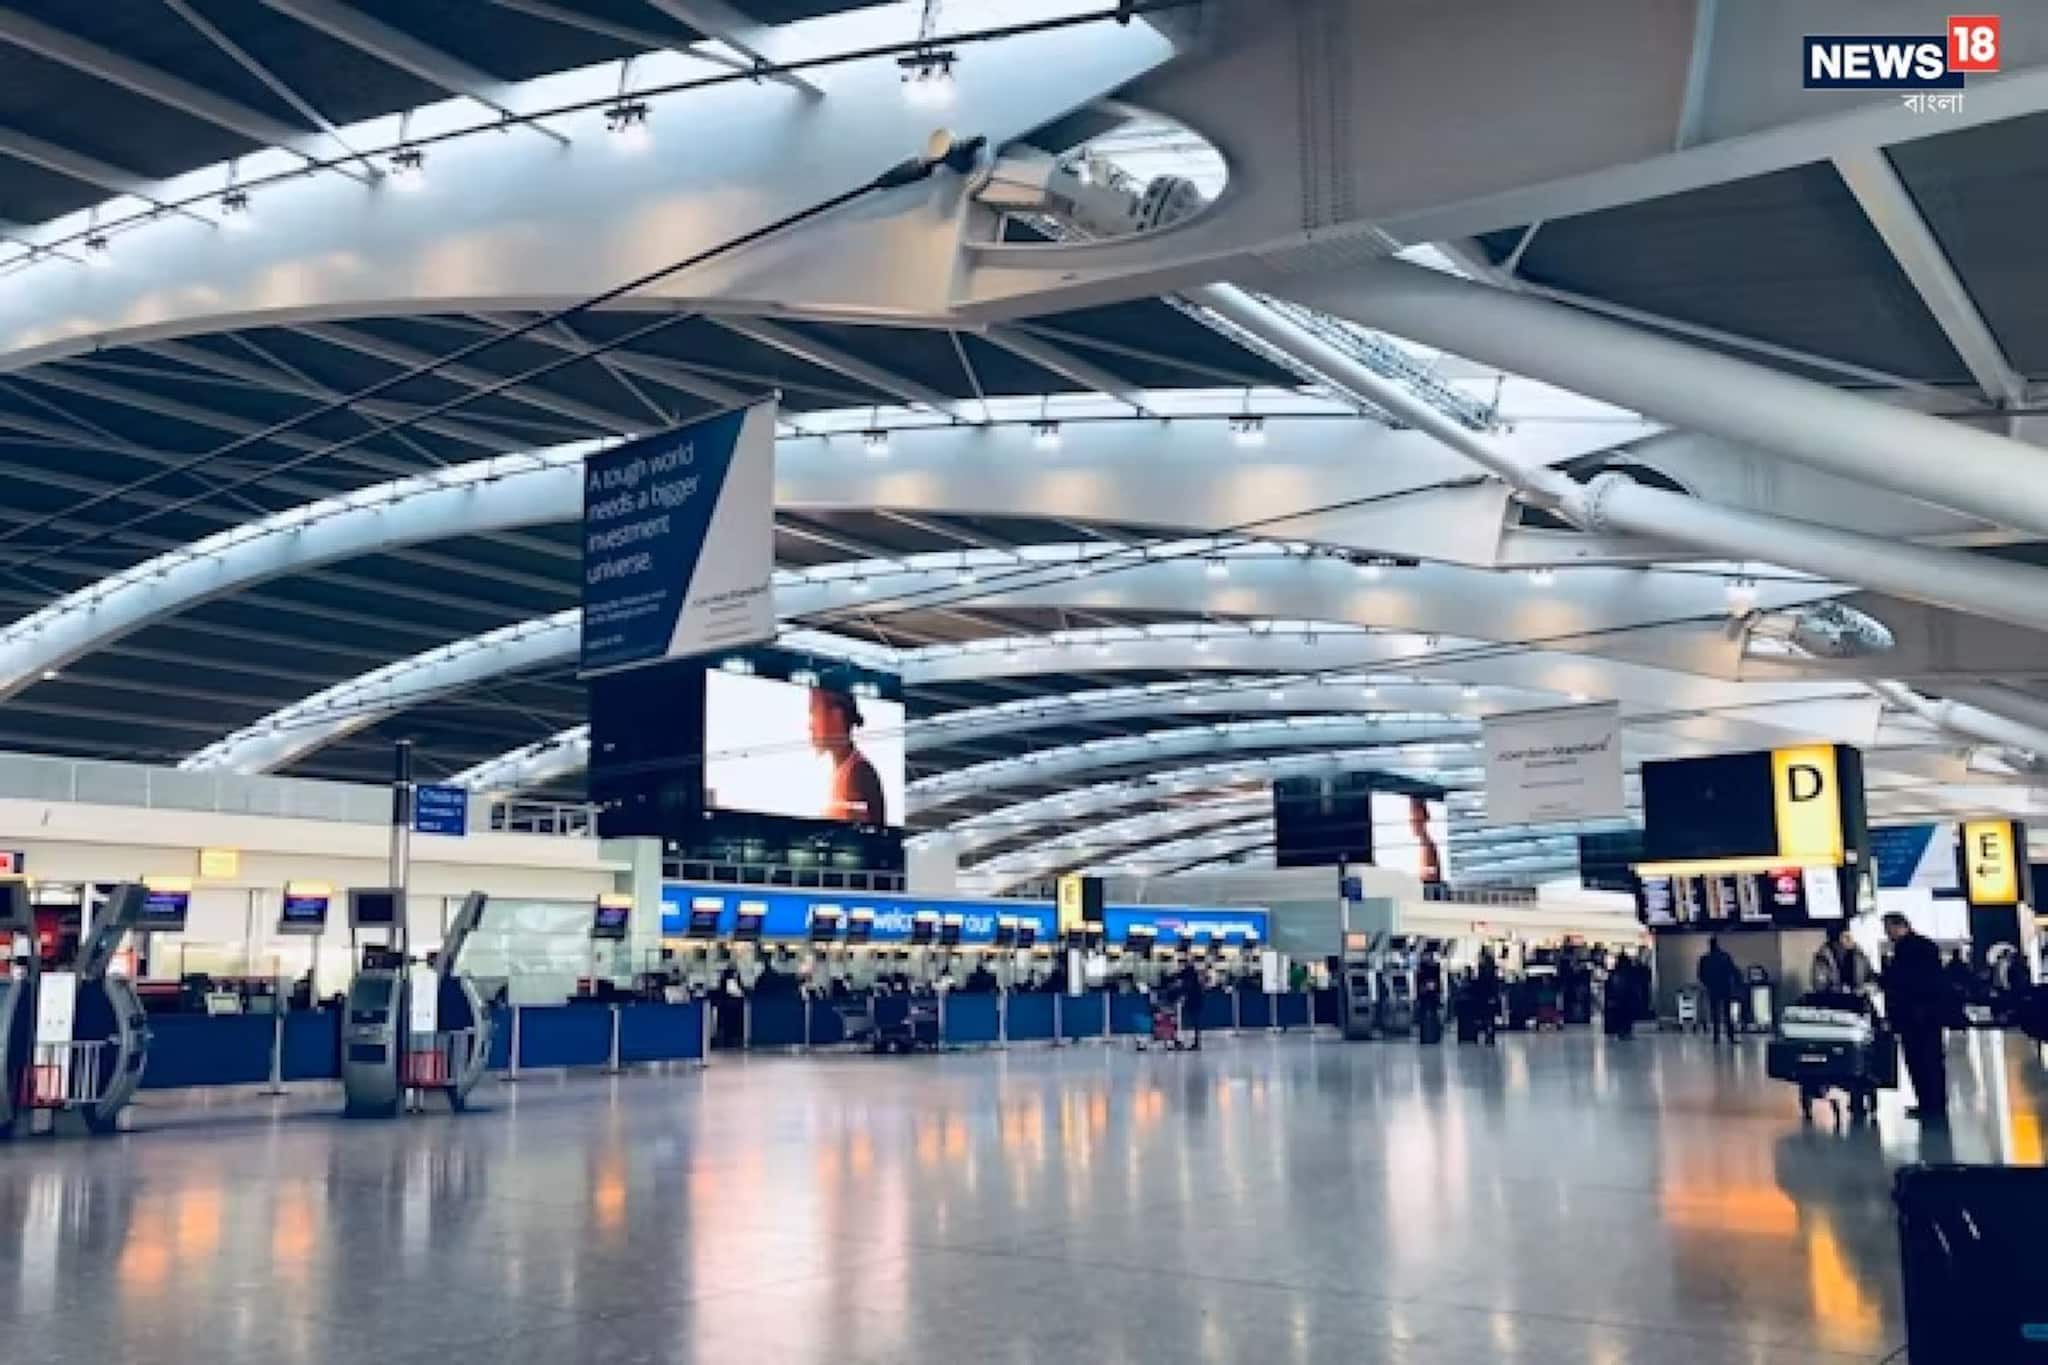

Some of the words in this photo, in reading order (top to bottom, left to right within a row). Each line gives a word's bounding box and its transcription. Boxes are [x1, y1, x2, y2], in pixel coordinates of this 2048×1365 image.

[588, 470, 602, 492] A
[604, 457, 646, 488] tough
[651, 440, 694, 474] world
[590, 490, 635, 520] needs
[637, 491, 650, 510] a
[651, 473, 700, 508] bigger
[588, 514, 671, 553] investment
[1788, 764, 1823, 802] D
[1979, 831, 2000, 860] E
